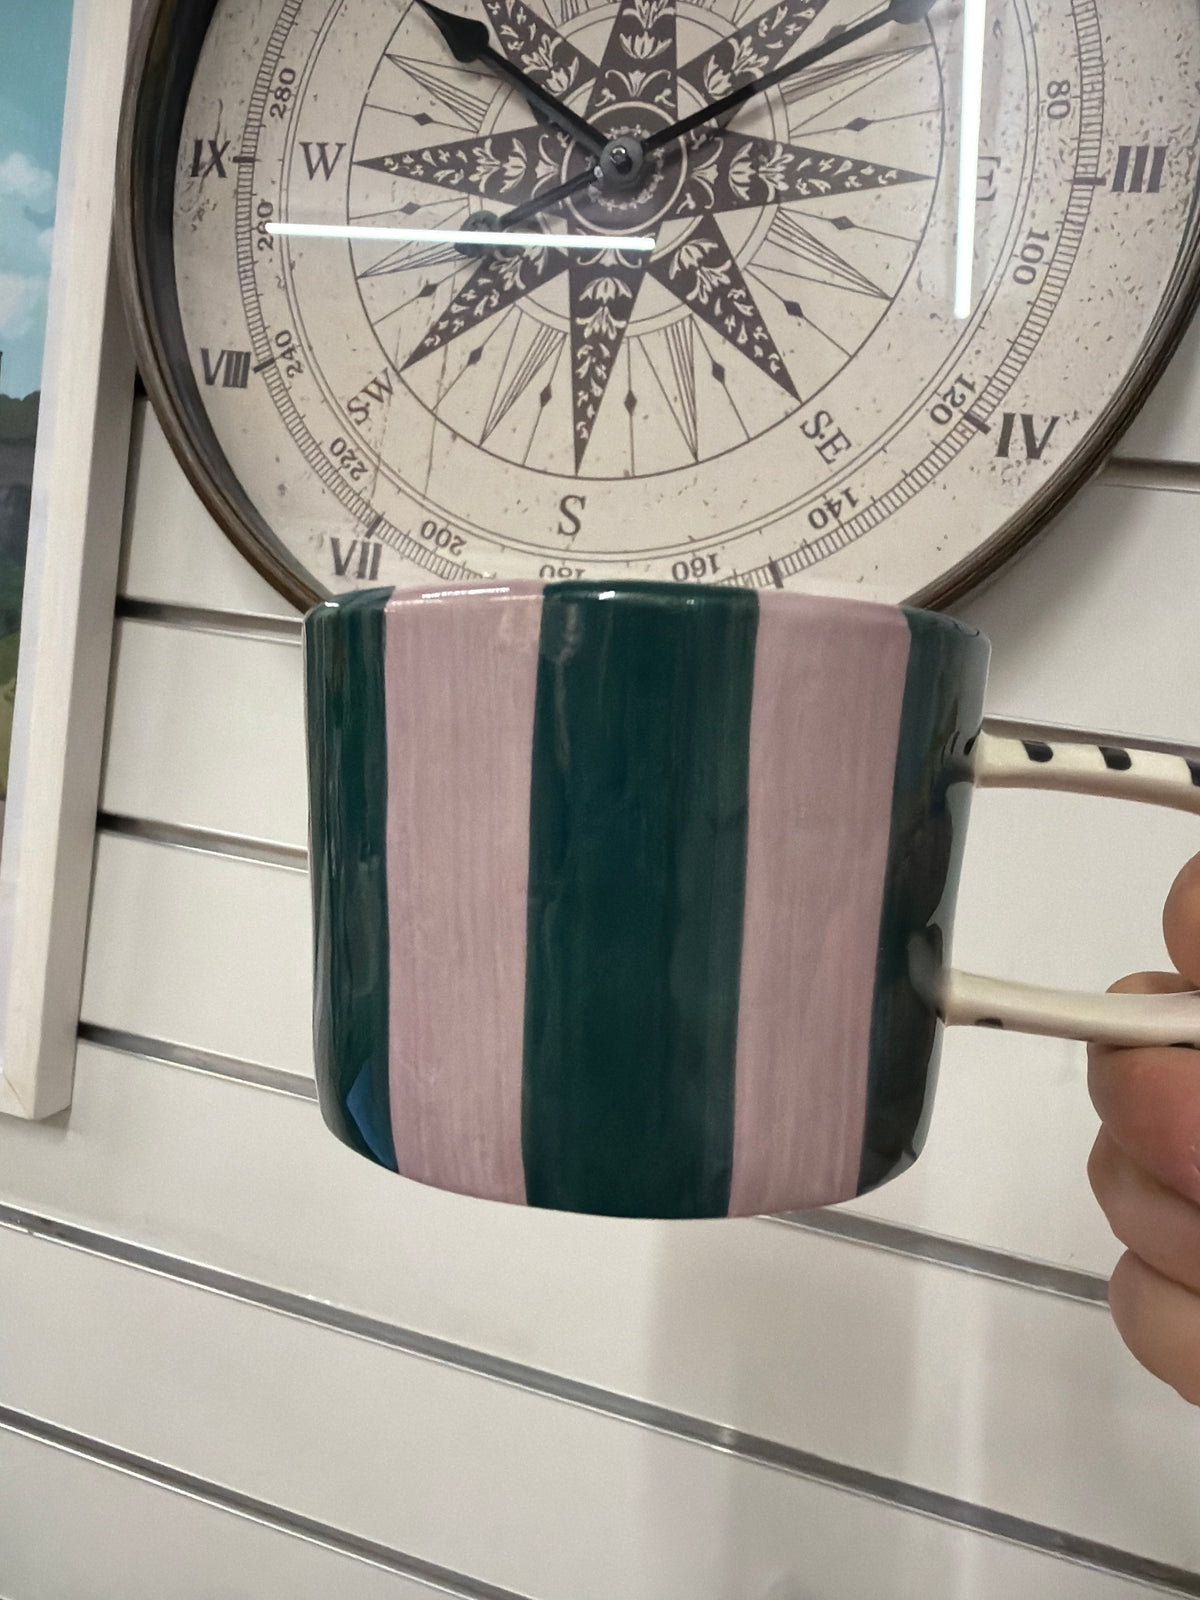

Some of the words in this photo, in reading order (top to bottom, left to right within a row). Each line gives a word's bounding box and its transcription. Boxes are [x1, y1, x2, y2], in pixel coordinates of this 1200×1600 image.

[269, 67, 297, 120] 280
[1046, 79, 1071, 120] 80
[190, 139, 231, 178] IX
[300, 142, 347, 181] W
[1111, 145, 1169, 193] III
[1012, 227, 1051, 286] 100
[200, 347, 252, 389] VIII
[274, 329, 304, 379] 240
[929, 373, 977, 427] 120
[994, 412, 1061, 460] IV
[329, 436, 369, 482] 220
[556, 494, 586, 537] S
[807, 486, 861, 531] 140
[330, 537, 383, 581] VII
[420, 519, 468, 557] 200
[671, 553, 720, 582] 160
